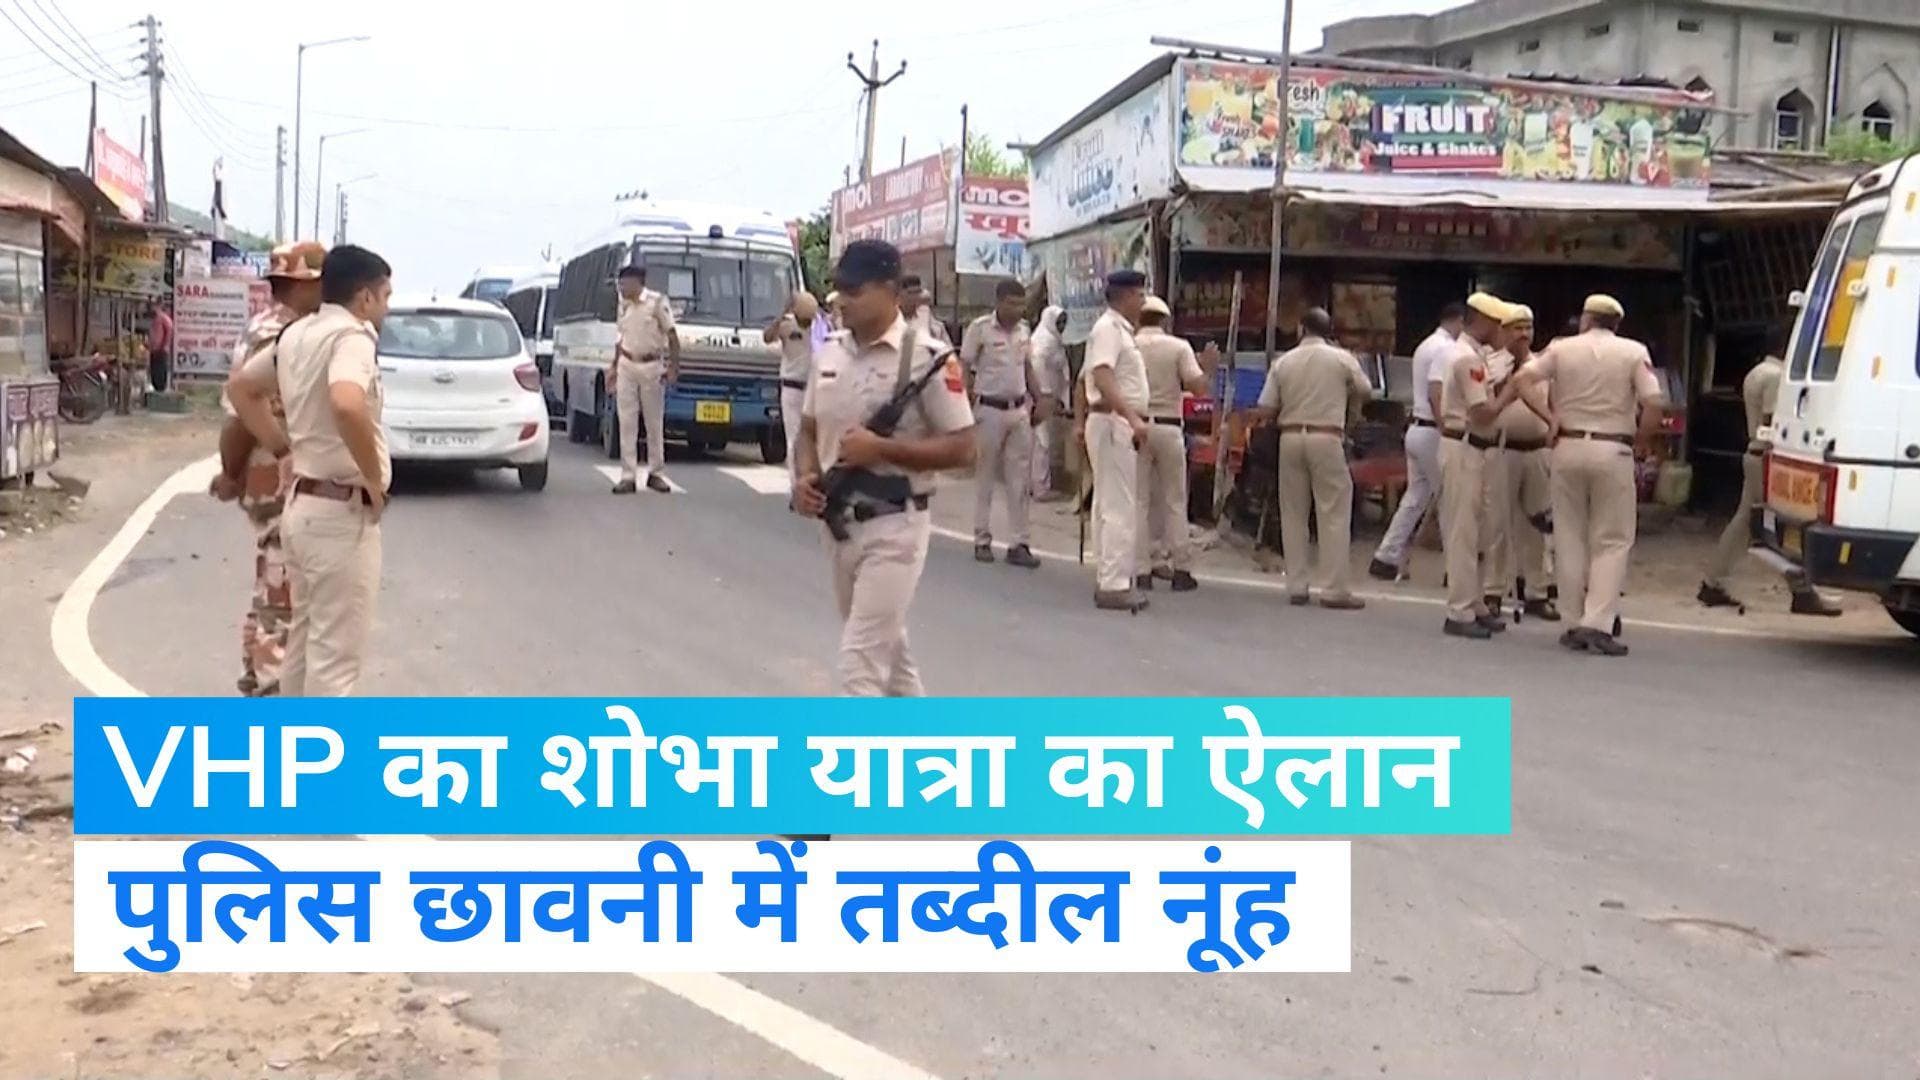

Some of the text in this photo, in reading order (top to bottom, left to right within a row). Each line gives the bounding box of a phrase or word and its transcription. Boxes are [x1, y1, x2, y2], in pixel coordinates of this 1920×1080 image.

[1278, 79, 1319, 101] resh
[1382, 100, 1489, 133] FRUIT
[1375, 142, 1498, 156] Juice & Shakes
[177, 285, 209, 299] SARA
